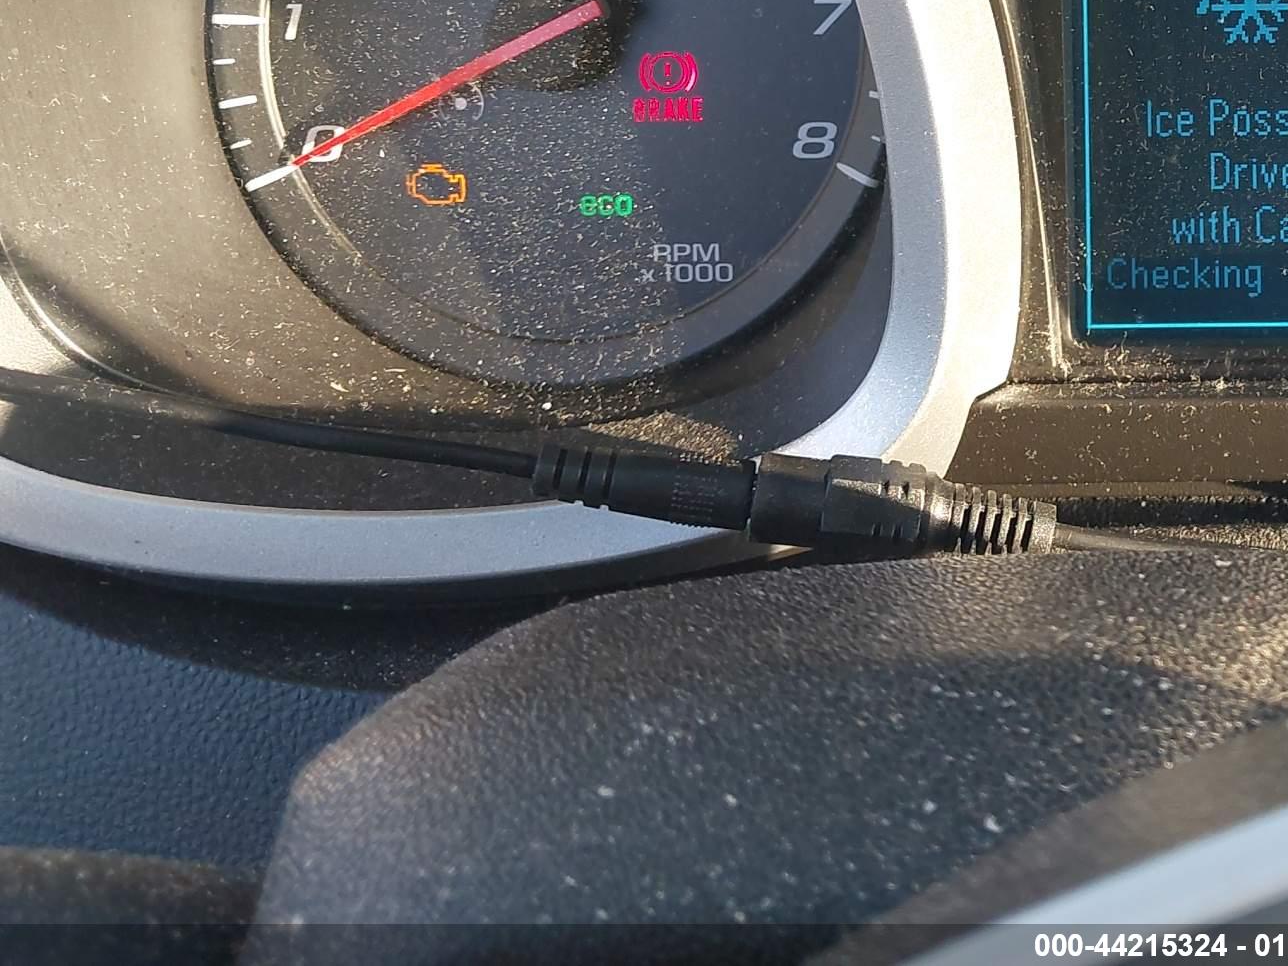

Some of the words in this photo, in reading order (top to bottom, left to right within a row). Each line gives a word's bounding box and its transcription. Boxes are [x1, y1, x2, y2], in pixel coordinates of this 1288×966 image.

[284, 2, 303, 40] 1
[632, 97, 704, 122] BRAKE
[1146, 99, 1194, 137] Ice
[301, 125, 346, 162] 0
[792, 122, 838, 159] 8
[1172, 207, 1241, 245] with
[653, 243, 721, 262] RPM
[665, 263, 734, 283] 1000
[1105, 257, 1263, 298] Checking
